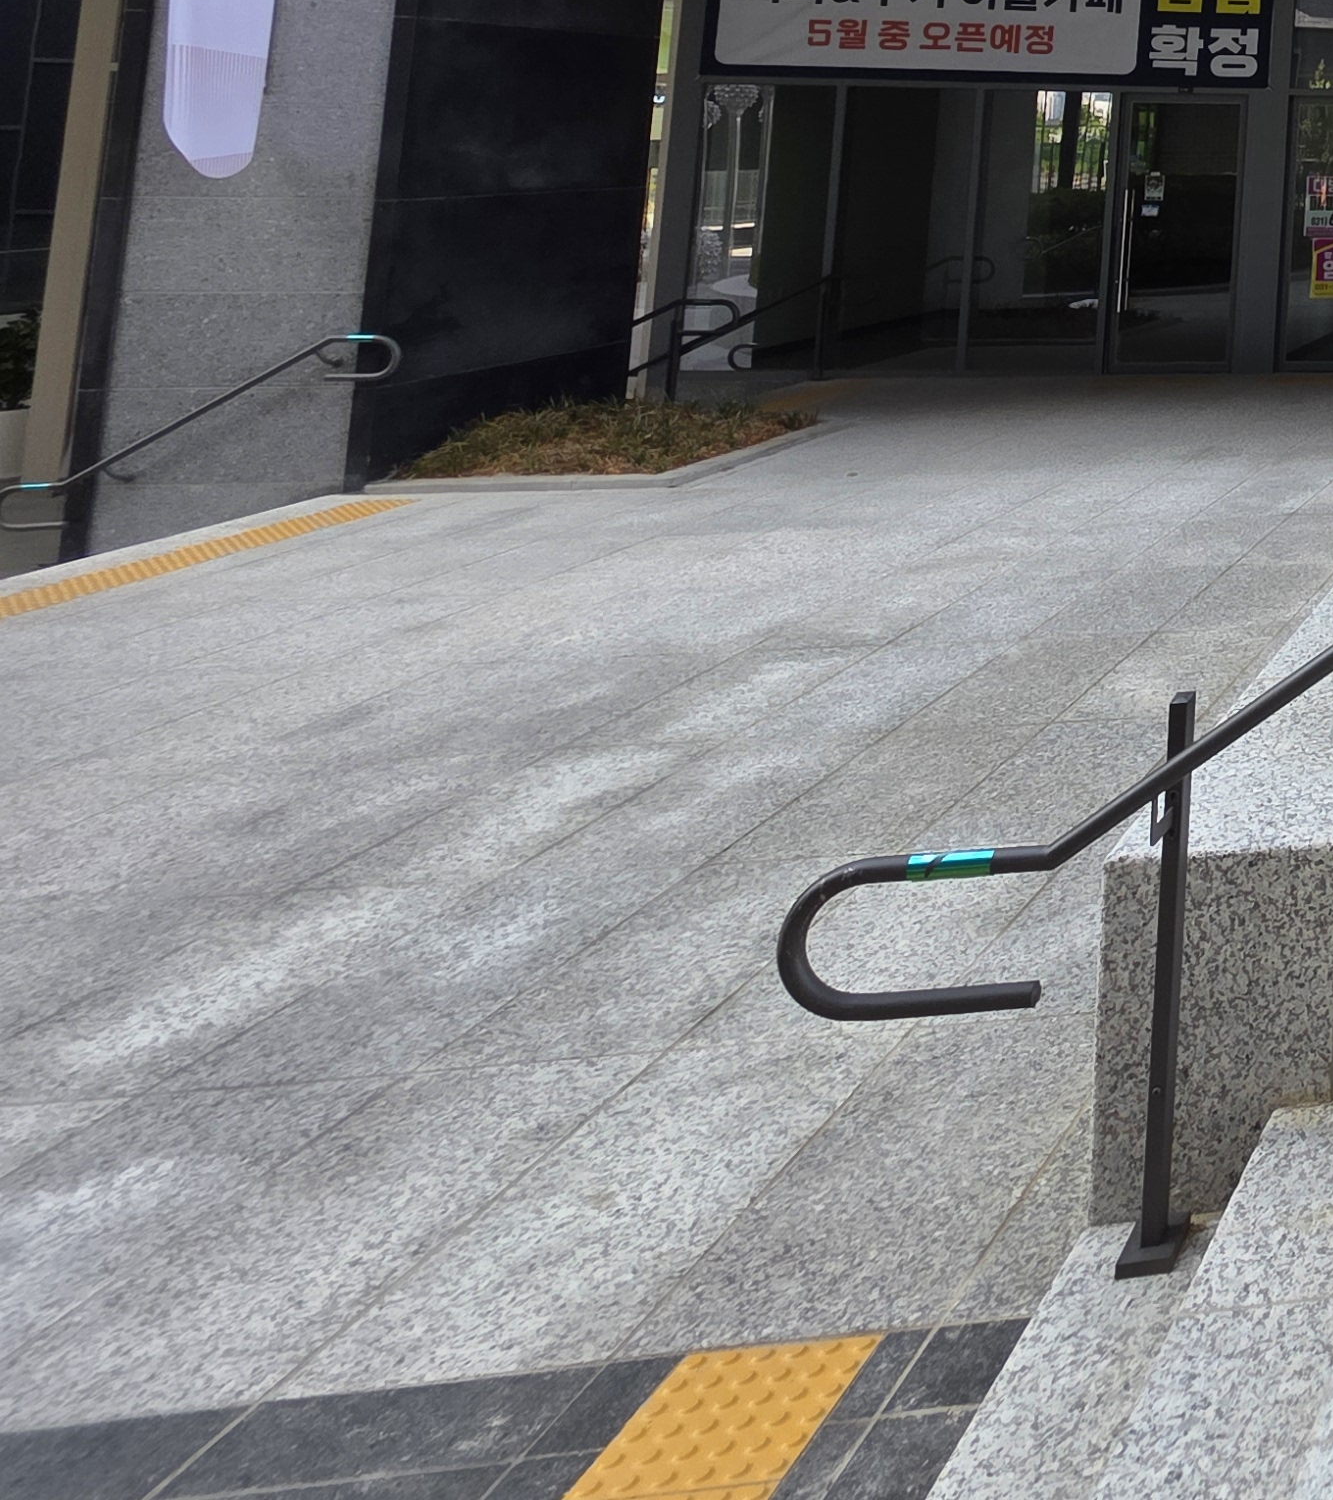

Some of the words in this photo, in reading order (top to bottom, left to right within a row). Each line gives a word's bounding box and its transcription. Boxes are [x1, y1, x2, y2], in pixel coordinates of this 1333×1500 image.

[807, 18, 868, 50] 5월
[878, 20, 911, 51] 중
[919, 22, 1055, 55] 오픈예정
[1149, 24, 1259, 78] 확정
